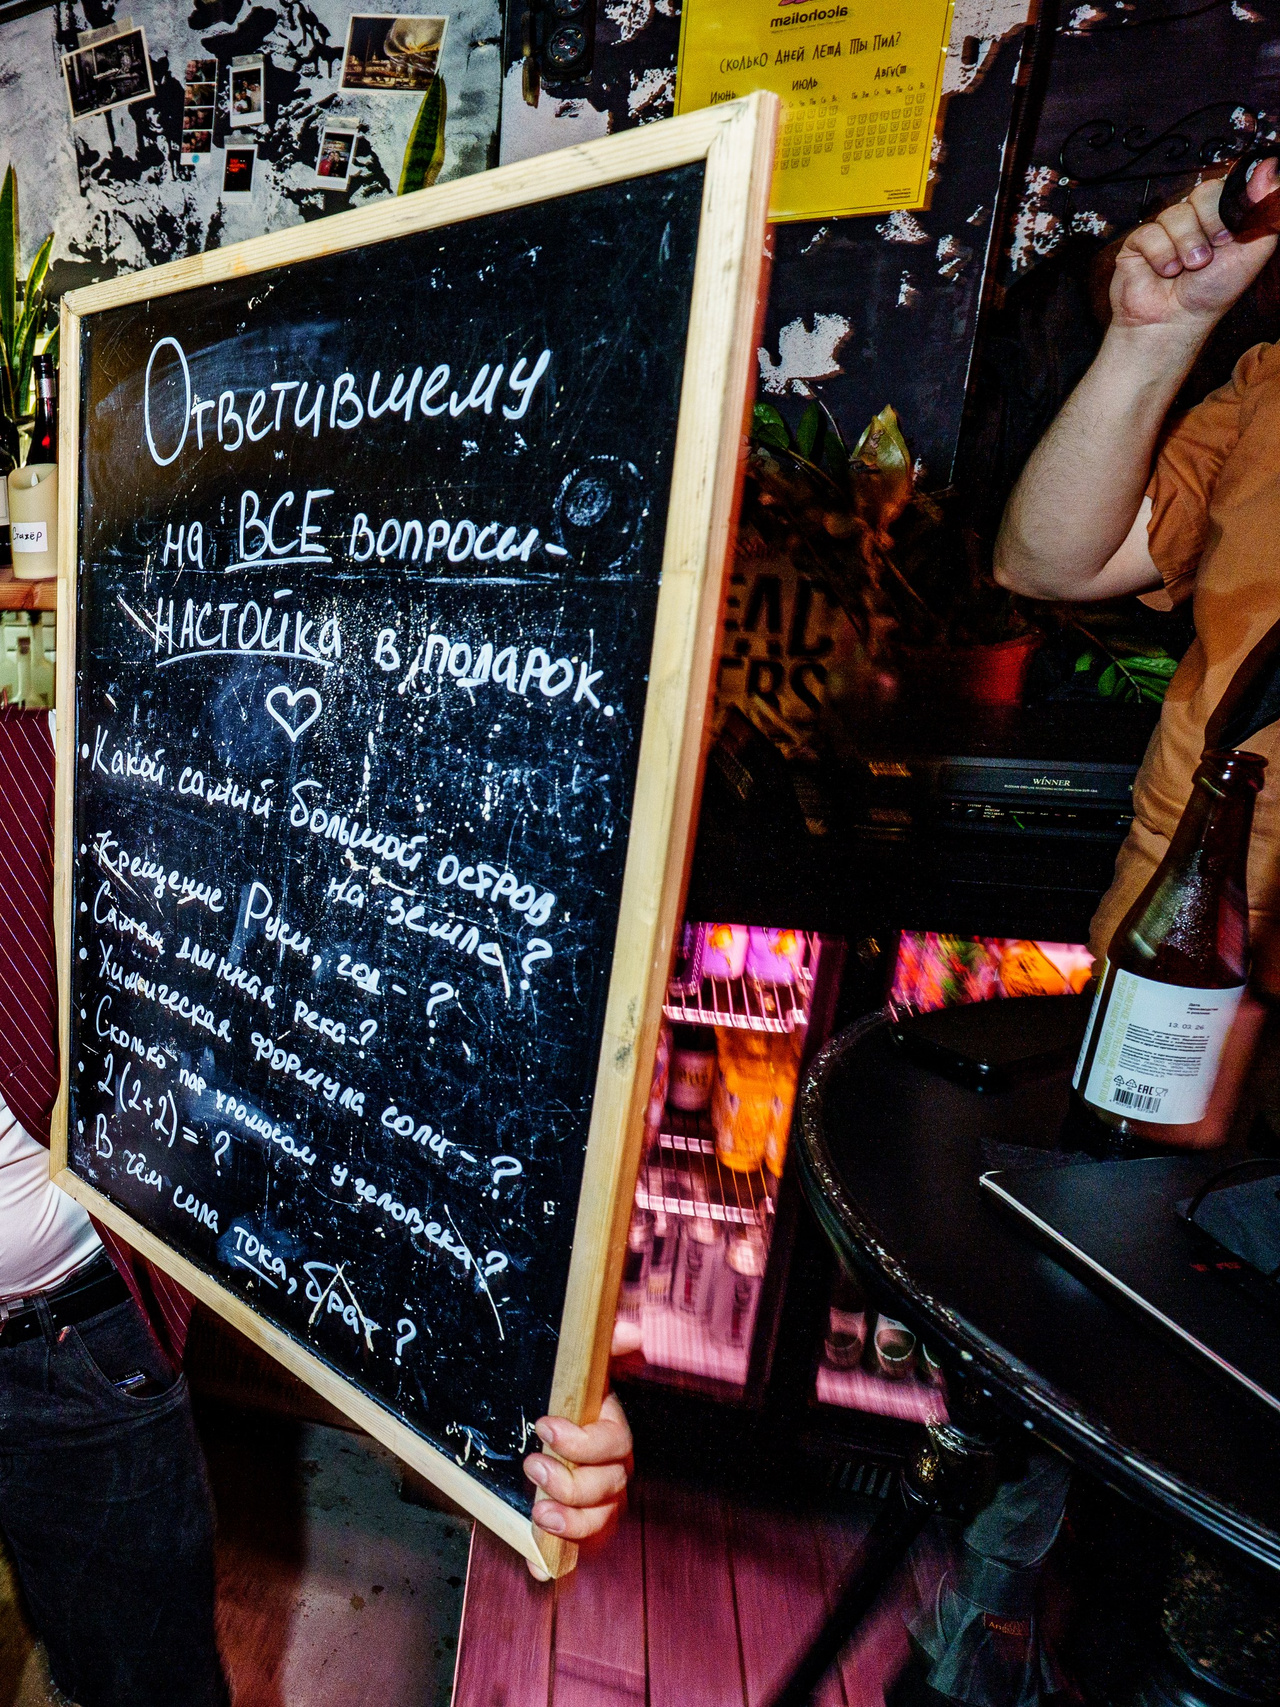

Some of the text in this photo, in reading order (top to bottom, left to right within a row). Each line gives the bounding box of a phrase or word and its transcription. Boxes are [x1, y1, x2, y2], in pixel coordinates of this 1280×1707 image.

[145, 335, 551, 467] Ответившему
[163, 521, 204, 569] на
[238, 489, 335, 562] ВСЕ
[92, 725, 165, 785] Какой
[178, 766, 274, 819] самый
[290, 779, 427, 871] большой
[94, 830, 225, 912] Крещение
[327, 878, 364, 909] на
[99, 939, 232, 1043] Химическая
[251, 1032, 365, 1117] формула
[175, 937, 276, 1009] длинная
[96, 995, 167, 1069] Сколько
[179, 1068, 207, 1096] пар
[216, 1089, 317, 1165] хромосом
[95, 1113, 114, 1158] В
[173, 1185, 219, 1234] сила
